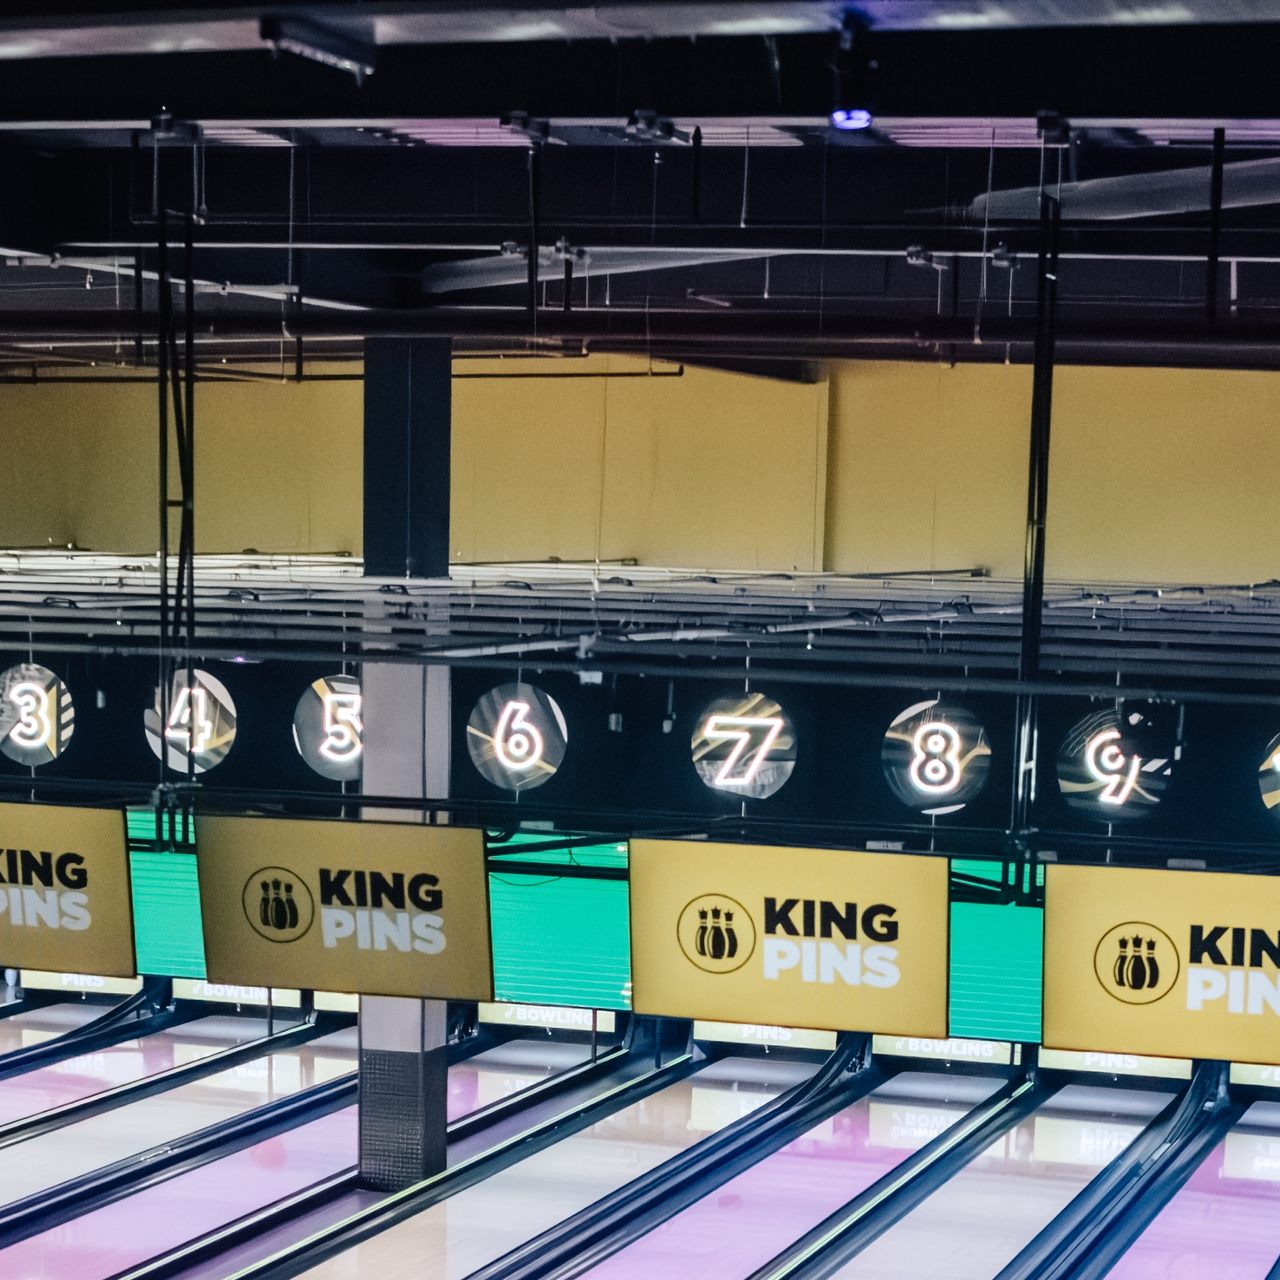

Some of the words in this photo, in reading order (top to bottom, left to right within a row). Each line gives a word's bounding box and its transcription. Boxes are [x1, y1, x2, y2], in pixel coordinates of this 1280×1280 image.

[9, 684, 51, 746] 3
[165, 687, 213, 753] 4
[320, 694, 362, 761] 5
[494, 702, 543, 769] 6
[702, 715, 784, 786] 7
[911, 723, 961, 793] 8
[1087, 730, 1140, 805] 9
[320, 869, 443, 911] KING
[321, 908, 446, 954] PINS
[764, 897, 899, 943] KING
[764, 937, 900, 988] PINS
[516, 1007, 594, 1026] BOWLING
[742, 1024, 792, 1041] PINS
[908, 1039, 993, 1057] BOWLING
[1085, 1052, 1139, 1069] PINS
